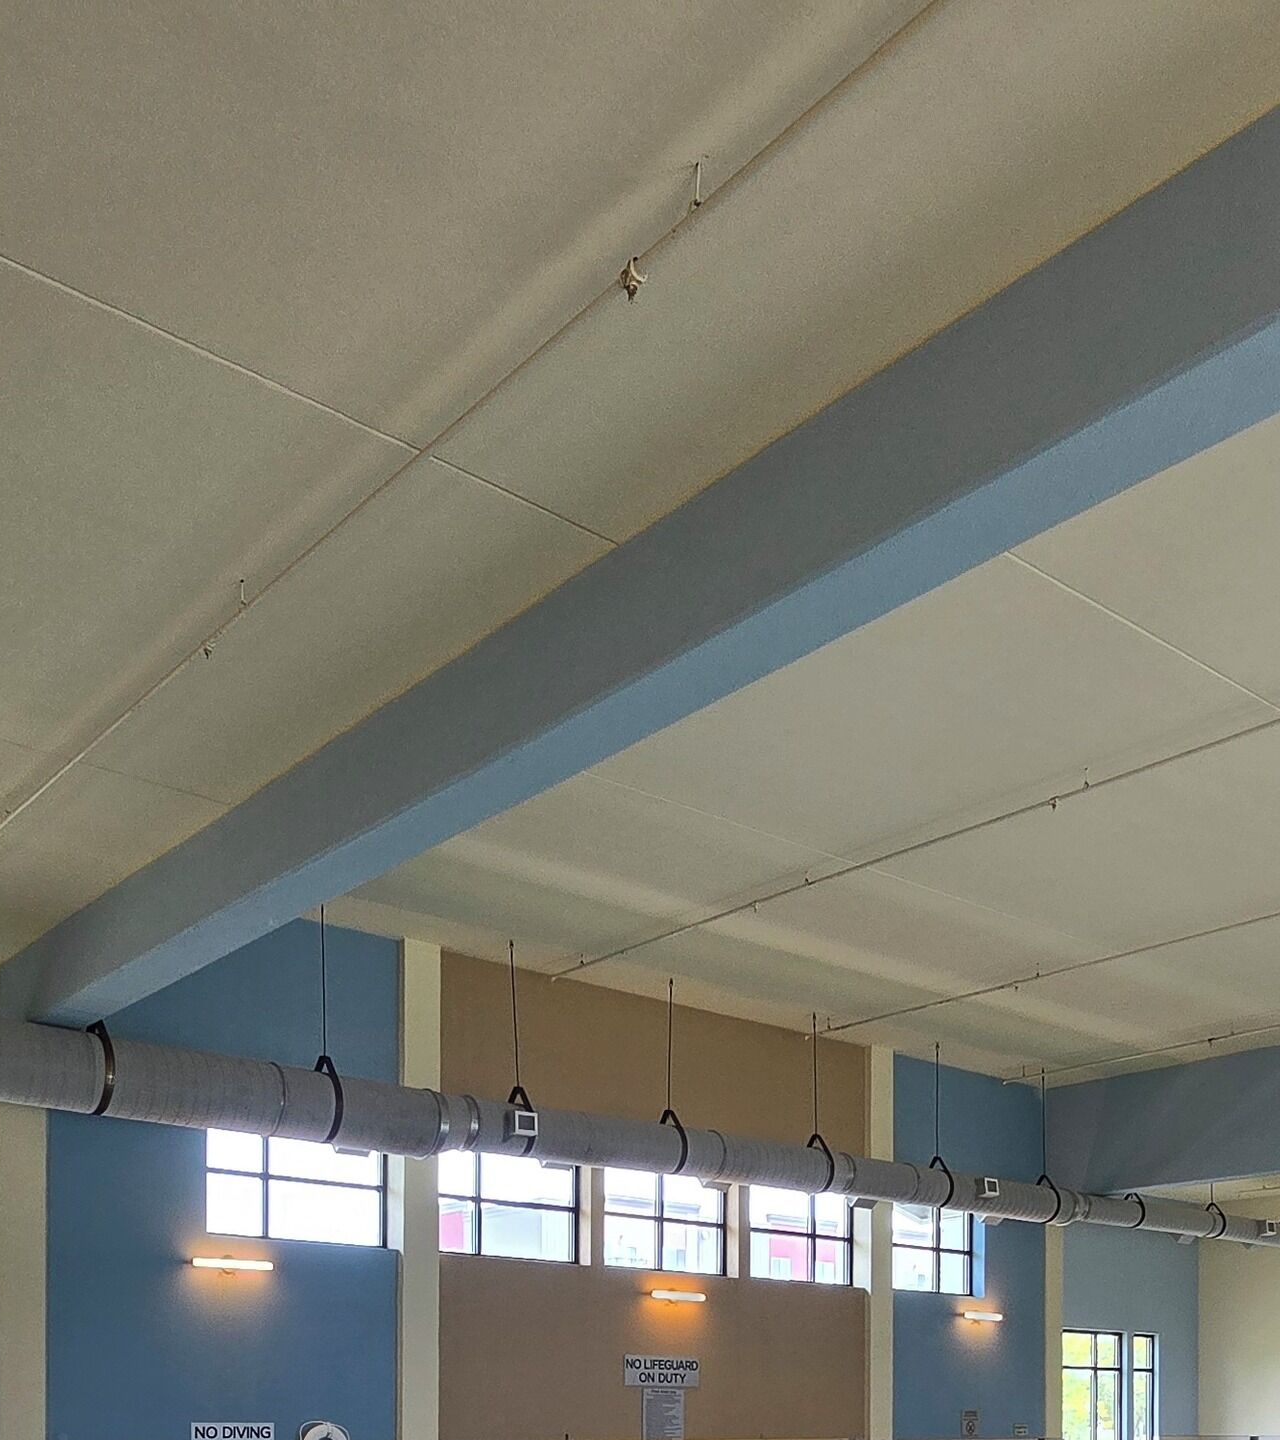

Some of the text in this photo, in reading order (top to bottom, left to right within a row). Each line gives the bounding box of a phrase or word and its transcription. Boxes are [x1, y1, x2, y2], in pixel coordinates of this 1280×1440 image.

[626, 1358, 699, 1371] NO LIFEGUARD
[638, 1372, 687, 1384] ON DUTY
[194, 1426, 271, 1439] NO DIVING
